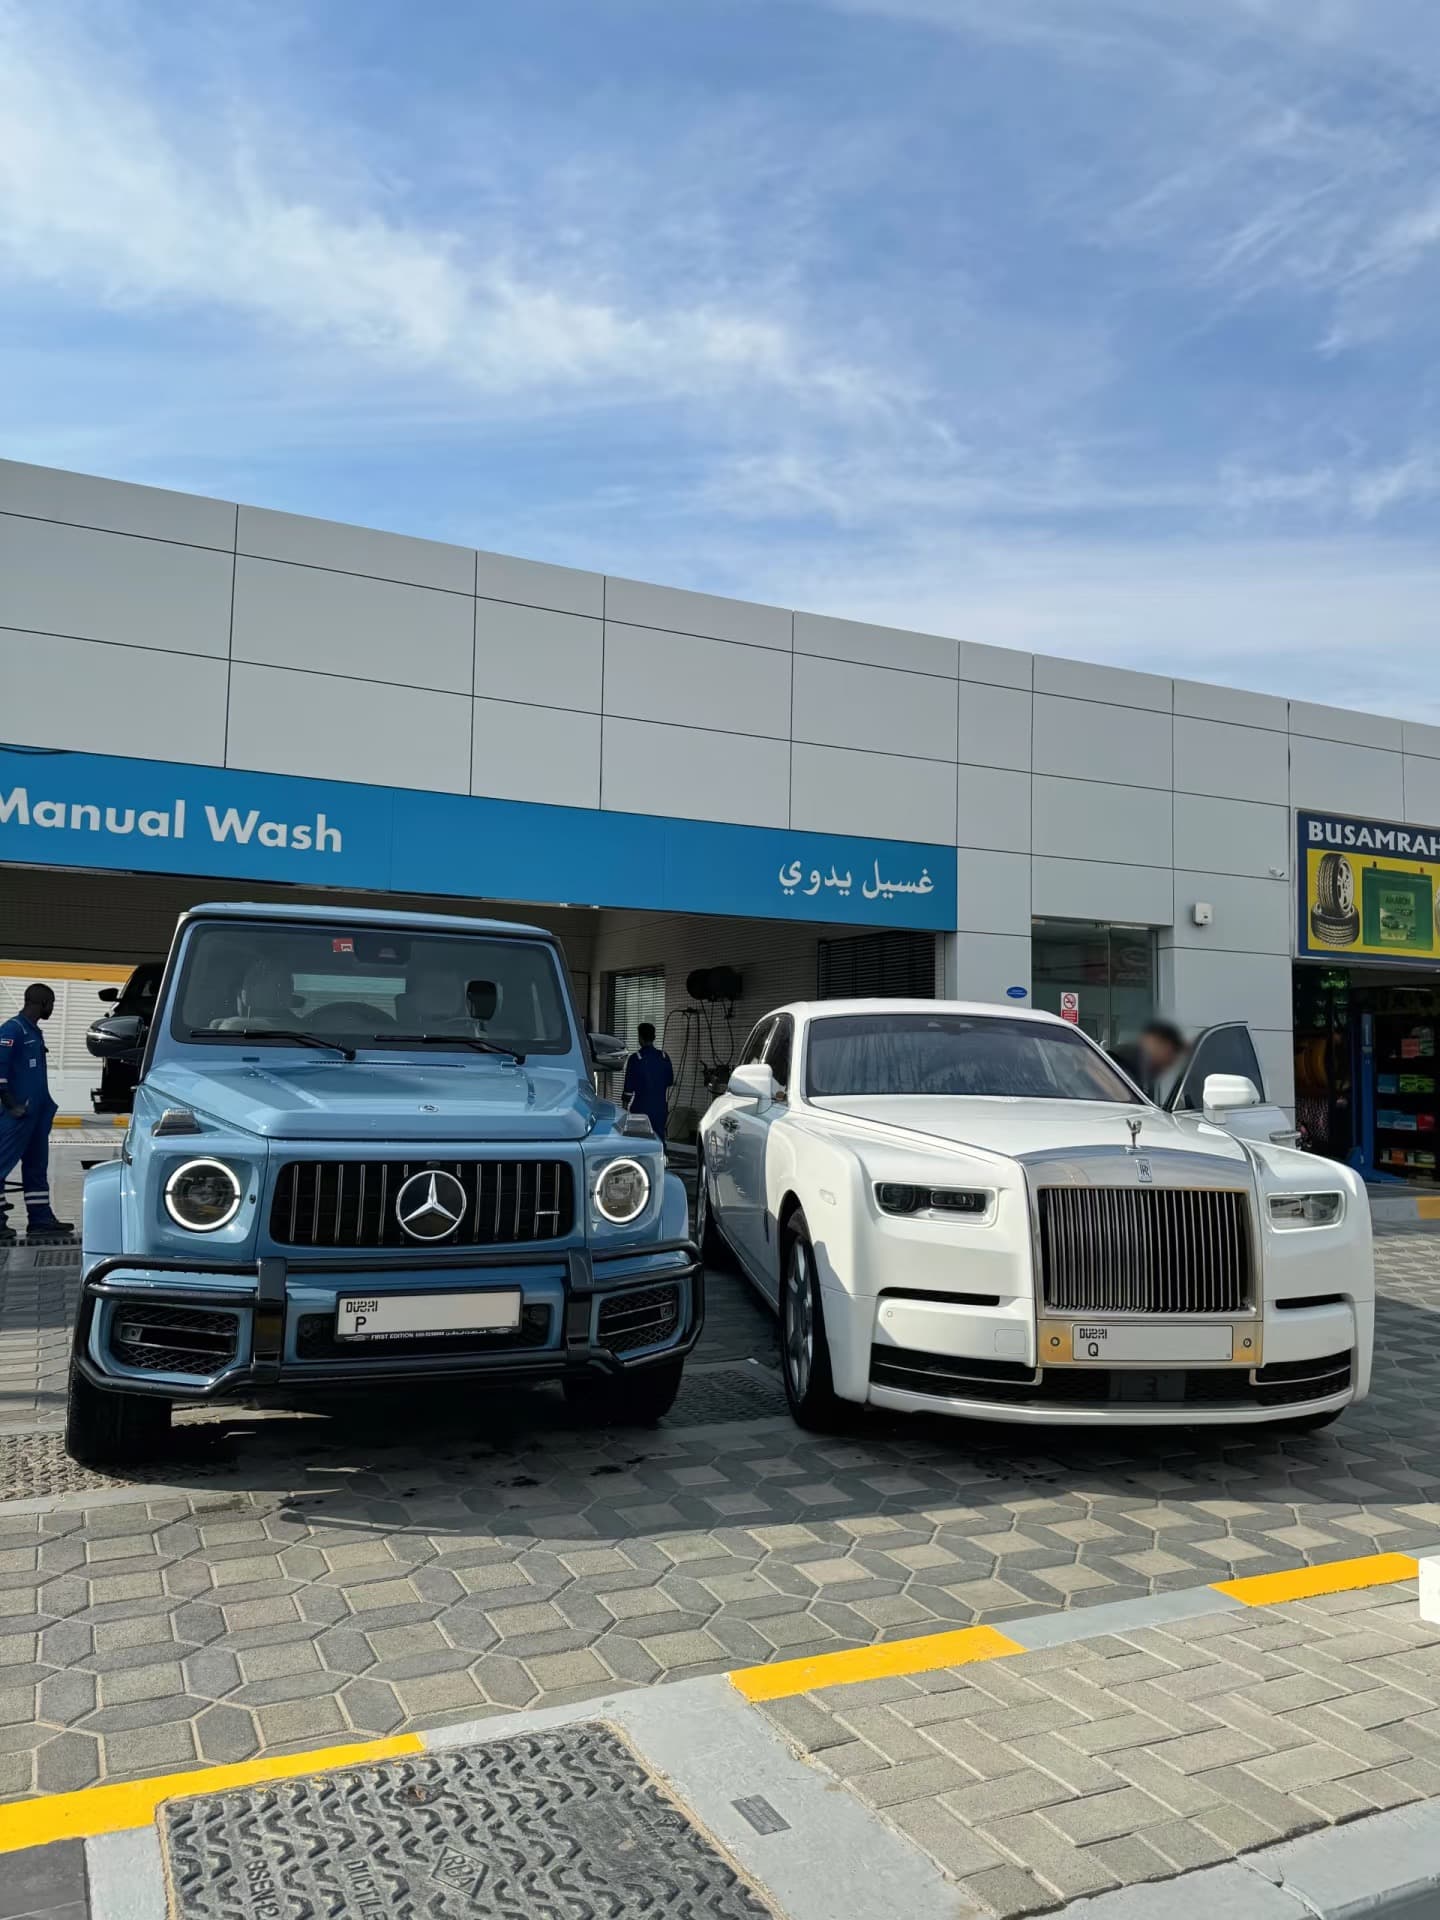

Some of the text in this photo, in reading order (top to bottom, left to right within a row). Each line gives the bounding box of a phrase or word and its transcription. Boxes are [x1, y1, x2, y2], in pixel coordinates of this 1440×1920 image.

[0, 787, 343, 853] Manual Wash
[1307, 820, 1440, 857] BUSAMRAH
[778, 857, 935, 899] غسيل يدوي
[355, 1316, 367, 1333] P
[389, 1331, 414, 1340] EDITION
[1087, 1342, 1099, 1357] Q
